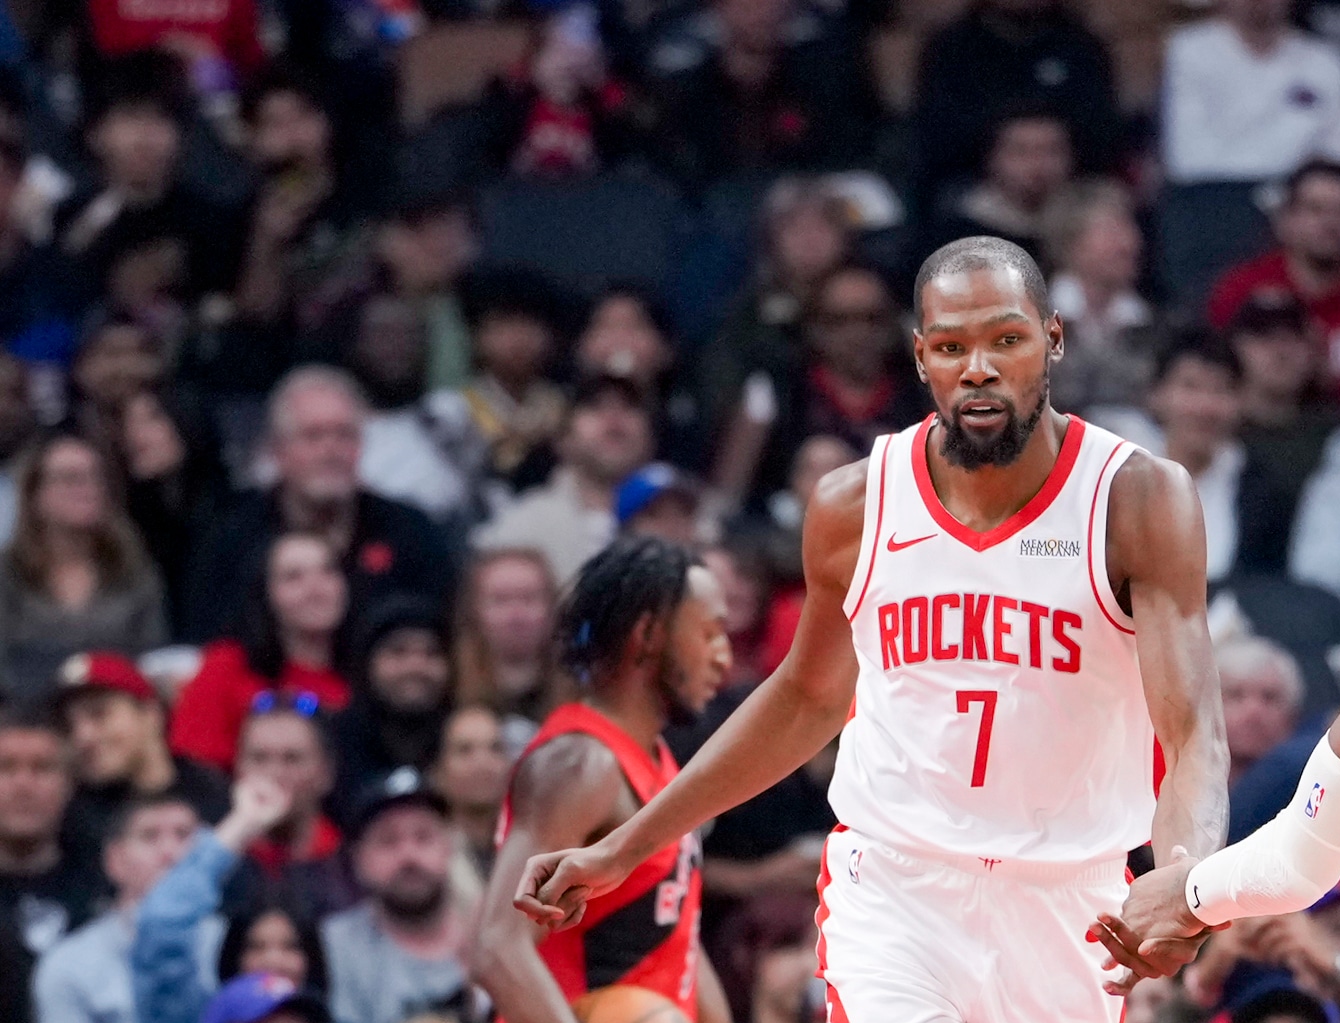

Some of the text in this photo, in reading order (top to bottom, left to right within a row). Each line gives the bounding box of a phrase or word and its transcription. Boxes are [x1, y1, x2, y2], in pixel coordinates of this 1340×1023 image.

[1019, 547, 1080, 557] HERMANN
[1020, 539, 1081, 549] MEMORIAL
[877, 592, 1084, 675] ROCKETS
[955, 690, 998, 788] 7
